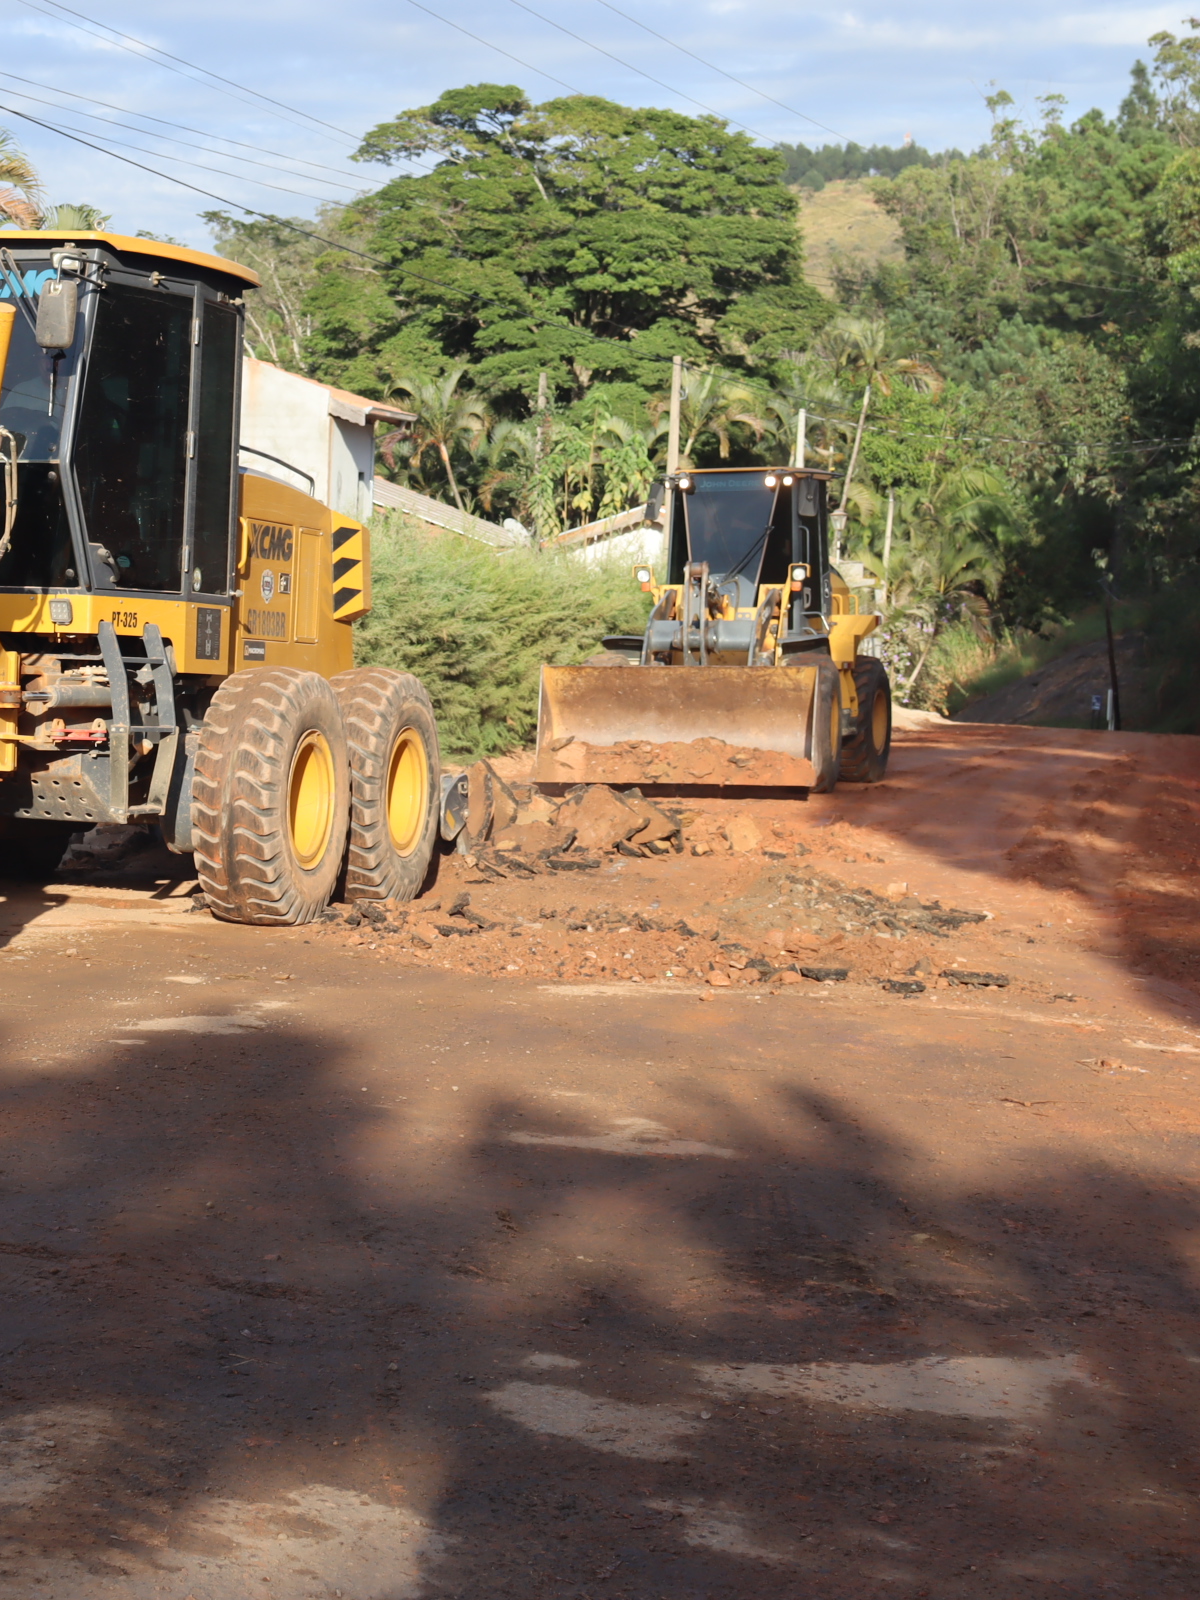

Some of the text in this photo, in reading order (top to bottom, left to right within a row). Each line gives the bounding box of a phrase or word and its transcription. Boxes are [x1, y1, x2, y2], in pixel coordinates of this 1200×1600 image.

[700, 477, 726, 488] JOHN
[249, 523, 293, 562] XCMG
[112, 611, 138, 628] PT-325
